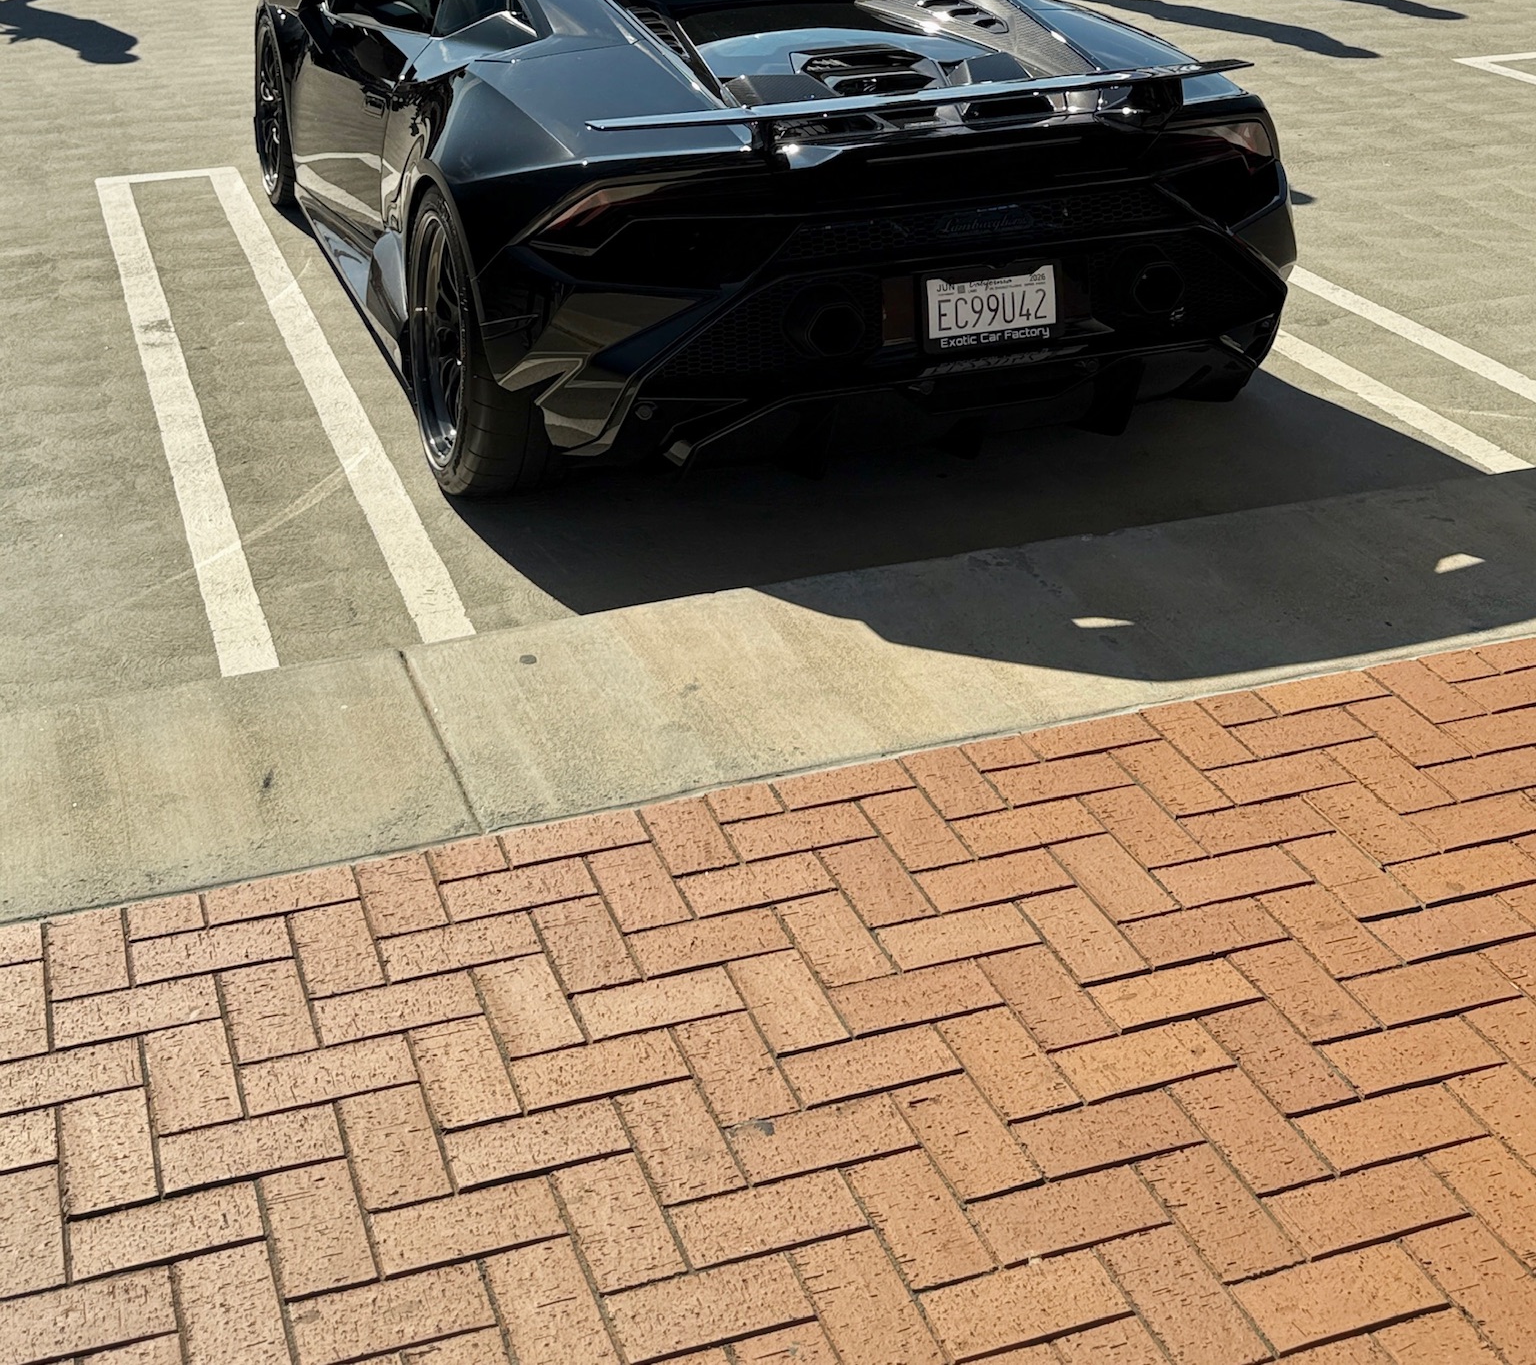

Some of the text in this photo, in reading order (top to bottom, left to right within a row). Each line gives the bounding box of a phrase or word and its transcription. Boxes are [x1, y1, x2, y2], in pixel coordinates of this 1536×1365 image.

[1029, 273, 1047, 282] 2026
[936, 283, 956, 293] JUN
[938, 288, 1048, 332] EC99U42
[940, 326, 1050, 349] Exotic Car Factory
